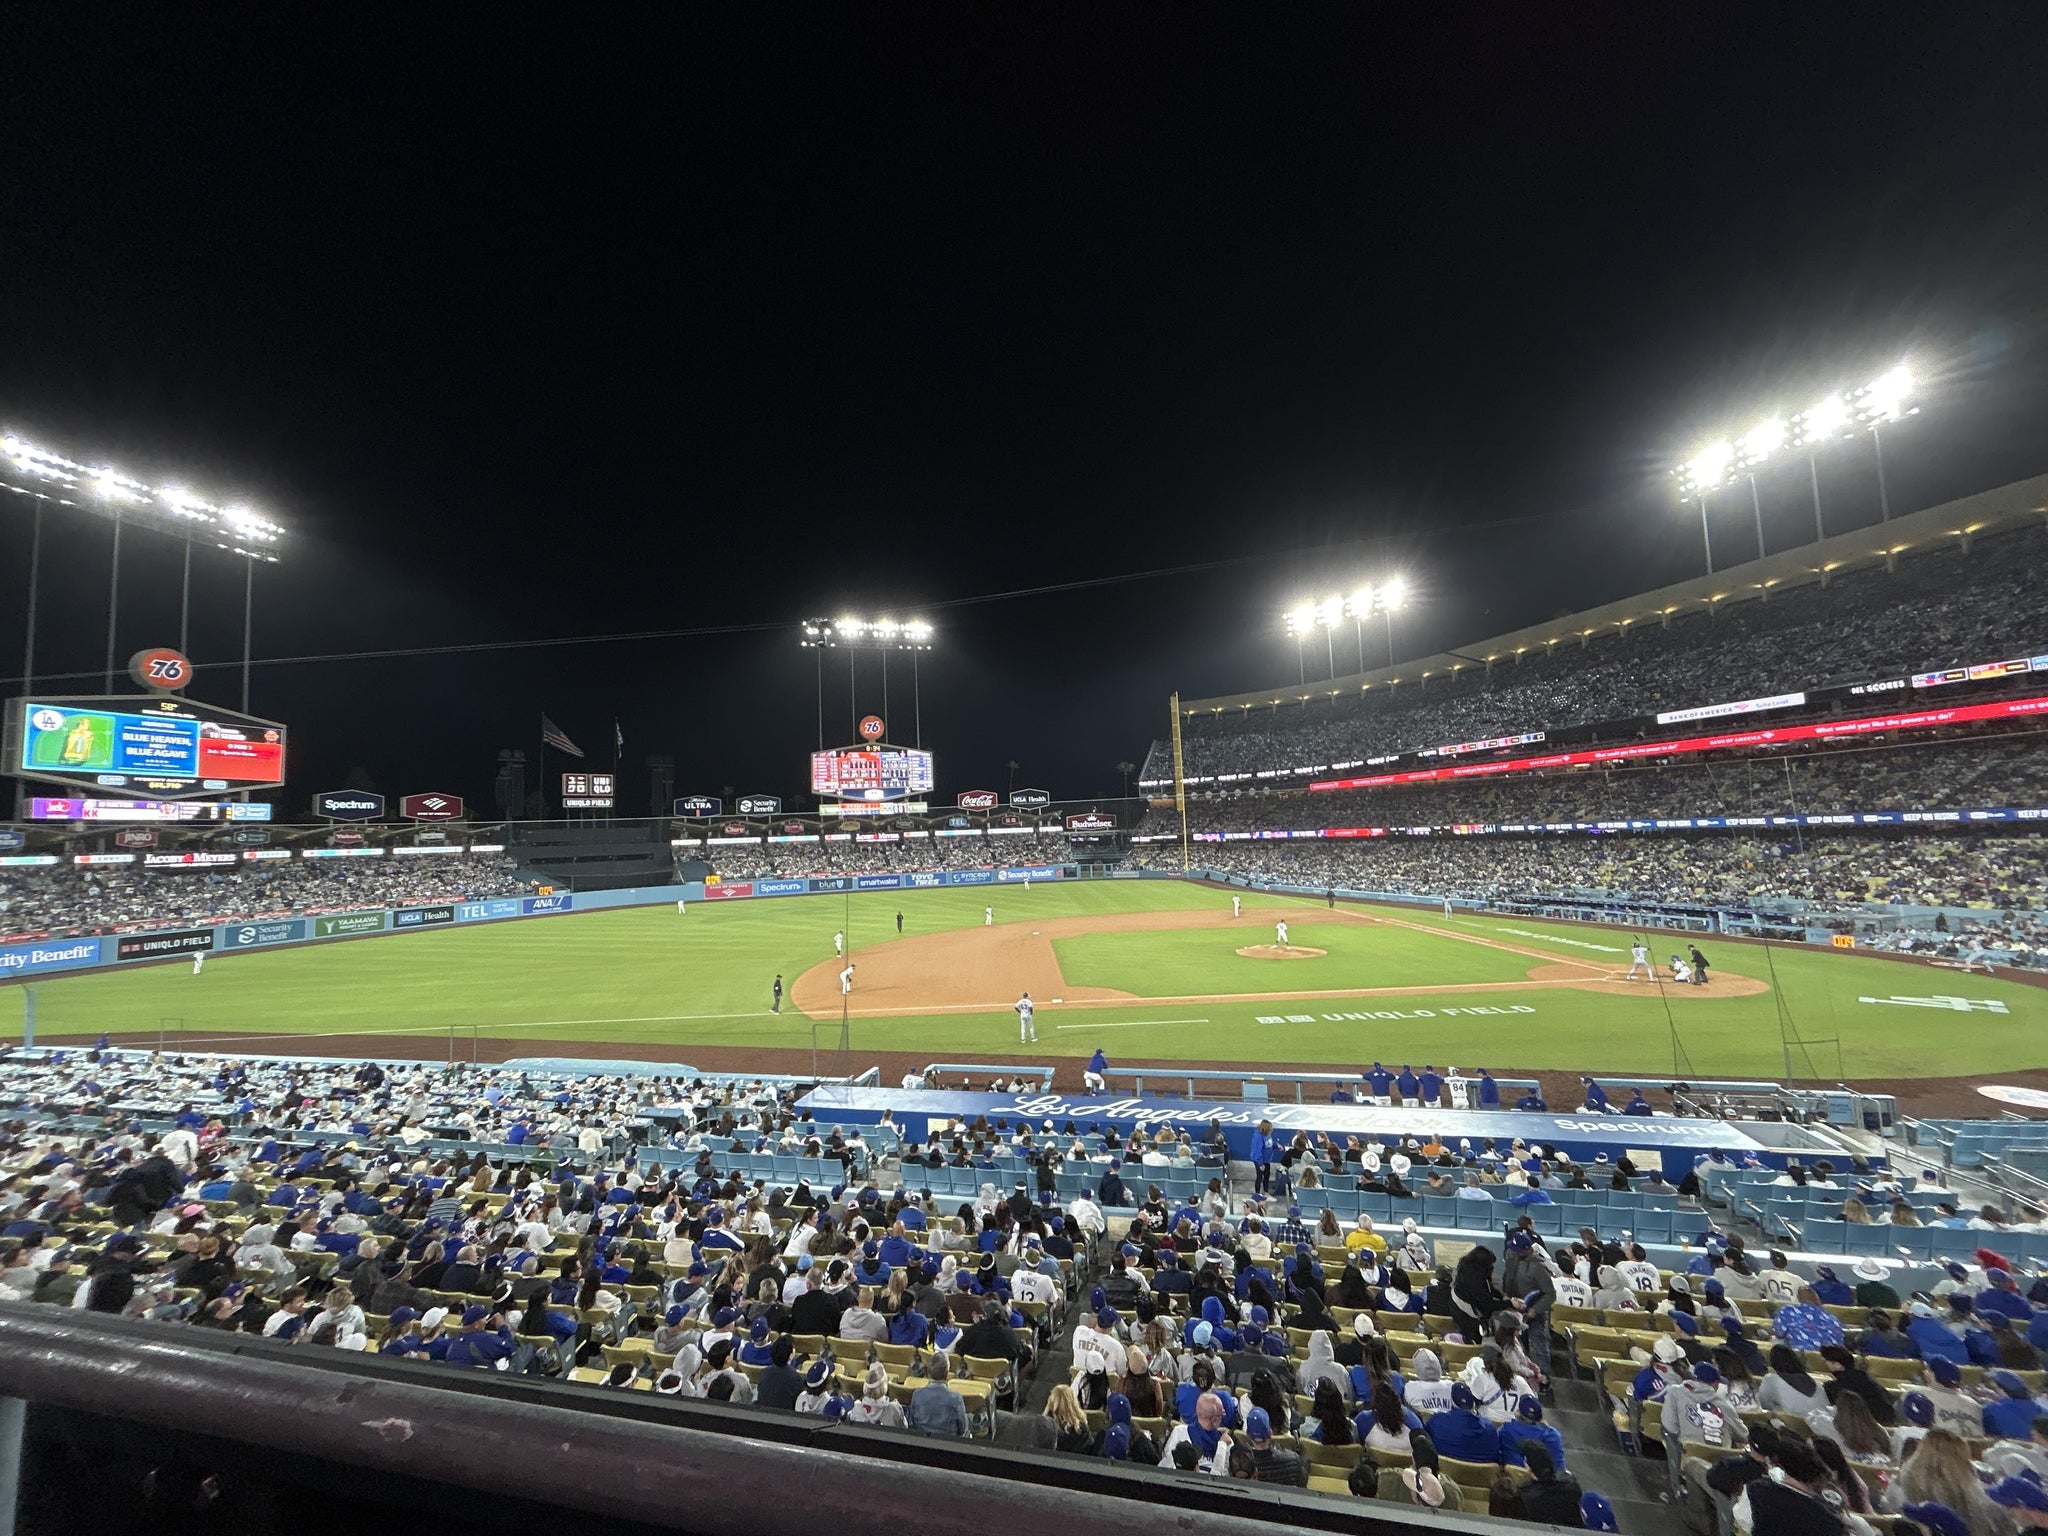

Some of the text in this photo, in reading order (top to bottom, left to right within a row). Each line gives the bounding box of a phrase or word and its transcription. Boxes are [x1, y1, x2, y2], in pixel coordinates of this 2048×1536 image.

[150, 659, 182, 680] 76
[1866, 680, 1904, 692] SCORES
[1700, 708, 1732, 716] AMERICA
[1901, 717, 1925, 725] power
[864, 721, 880, 734] 76
[122, 732, 192, 746] BLUE HEAVEN,
[126, 747, 188, 758] BLUE AGAVE
[594, 776, 610, 785] UNI
[594, 785, 611, 794] QLO
[325, 800, 374, 810] Spectrum
[753, 800, 777, 808] Security
[1072, 820, 1112, 828] Budweiser
[124, 833, 152, 843] JINRO
[144, 854, 183, 863] JACOBY
[183, 853, 194, 863] &
[1008, 870, 1030, 879] Security
[761, 884, 798, 892] Spectrum
[532, 899, 554, 908] ANA
[424, 911, 450, 920] Health
[462, 906, 488, 918] TEL
[259, 924, 293, 933] Security
[259, 932, 288, 942] Benefit
[144, 936, 211, 950] UNIQLO FIELD
[32, 946, 92, 963] Benefit
[1322, 1010, 1436, 1022] UNIQLO
[1440, 1005, 1537, 1016] FIELD
[1453, 1083, 1464, 1091] 84
[990, 1095, 1070, 1117] Los
[1069, 1099, 1251, 1124] Angeles
[1554, 1118, 1710, 1136] Spectrum
[1635, 1277, 1653, 1291] 18
[1561, 1285, 1585, 1295] OHTANI
[1568, 1296, 1584, 1307] 17
[1078, 1340, 1110, 1360] FREEMAN
[1422, 1398, 1450, 1409] OHTANI
[1502, 1392, 1518, 1412] 17
